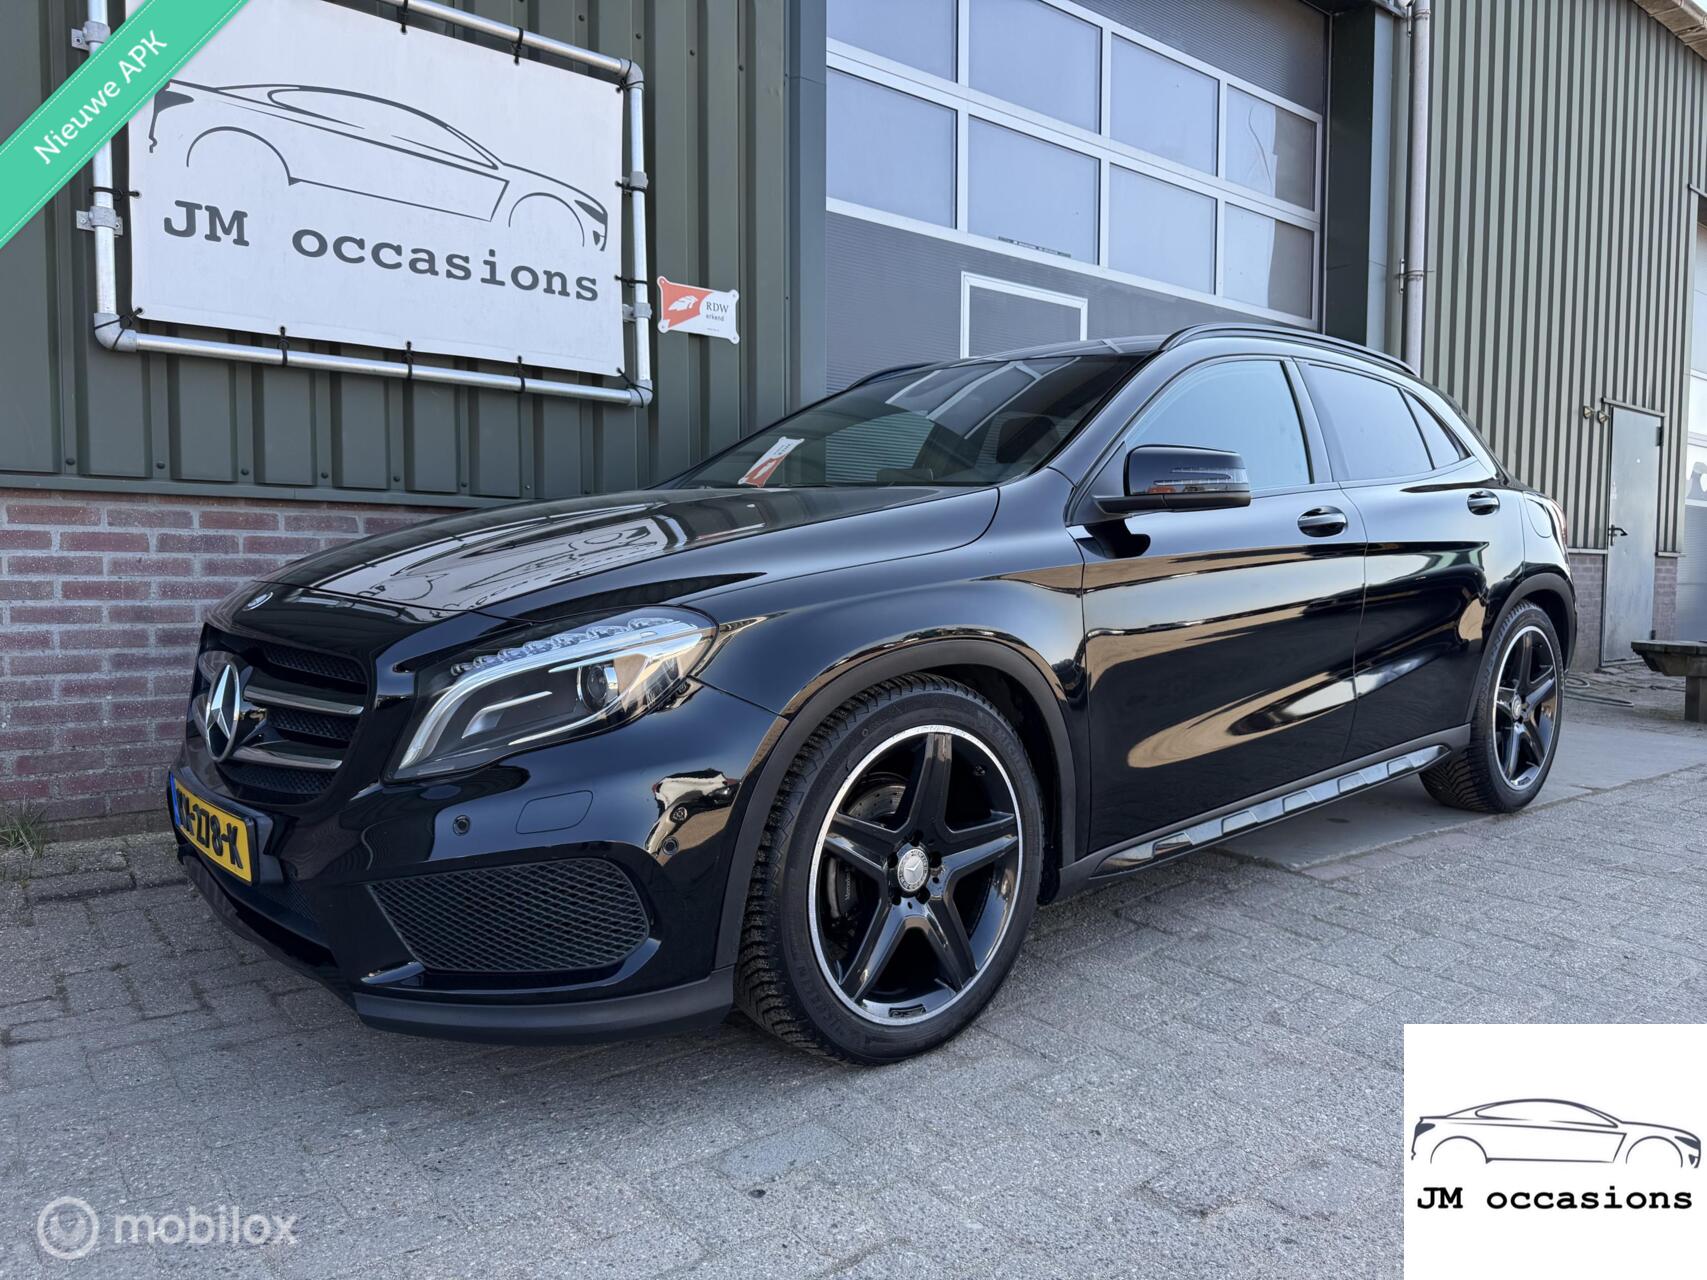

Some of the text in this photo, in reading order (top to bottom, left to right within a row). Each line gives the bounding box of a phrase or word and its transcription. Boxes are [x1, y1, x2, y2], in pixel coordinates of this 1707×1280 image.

[163, 199, 599, 301] JM occasions
[705, 301, 729, 313] RDW
